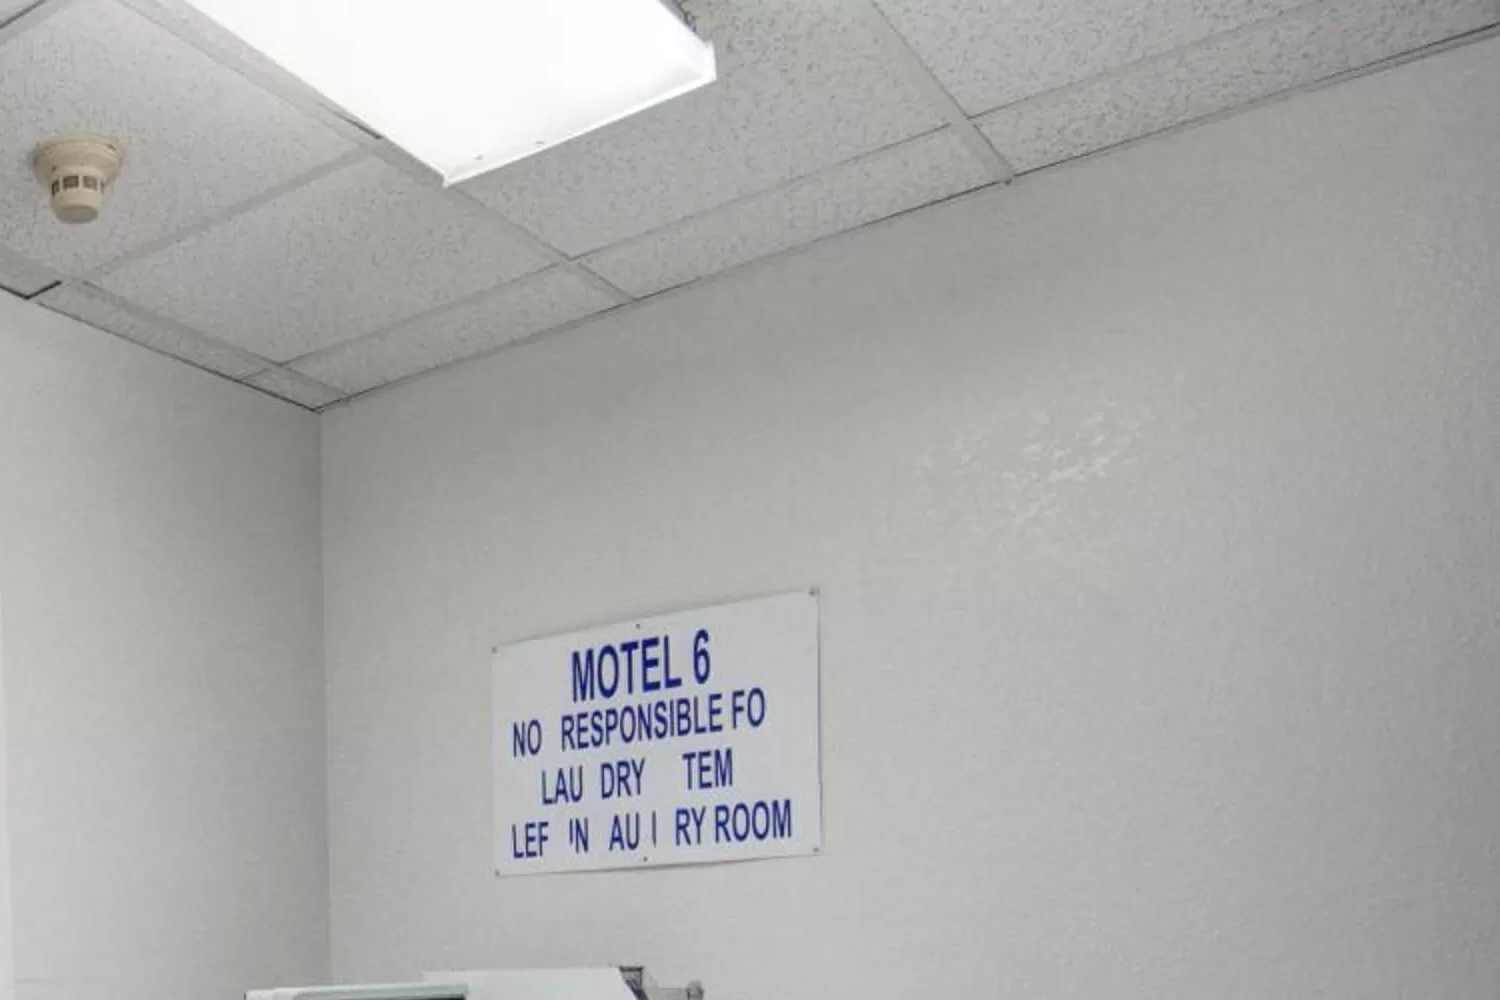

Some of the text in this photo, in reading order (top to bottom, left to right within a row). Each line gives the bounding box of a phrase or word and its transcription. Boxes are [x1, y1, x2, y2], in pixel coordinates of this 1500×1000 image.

[571, 628, 711, 702] MOTEL 6
[561, 693, 723, 751] RESPONSIBLE
[714, 799, 792, 844] ROOM
